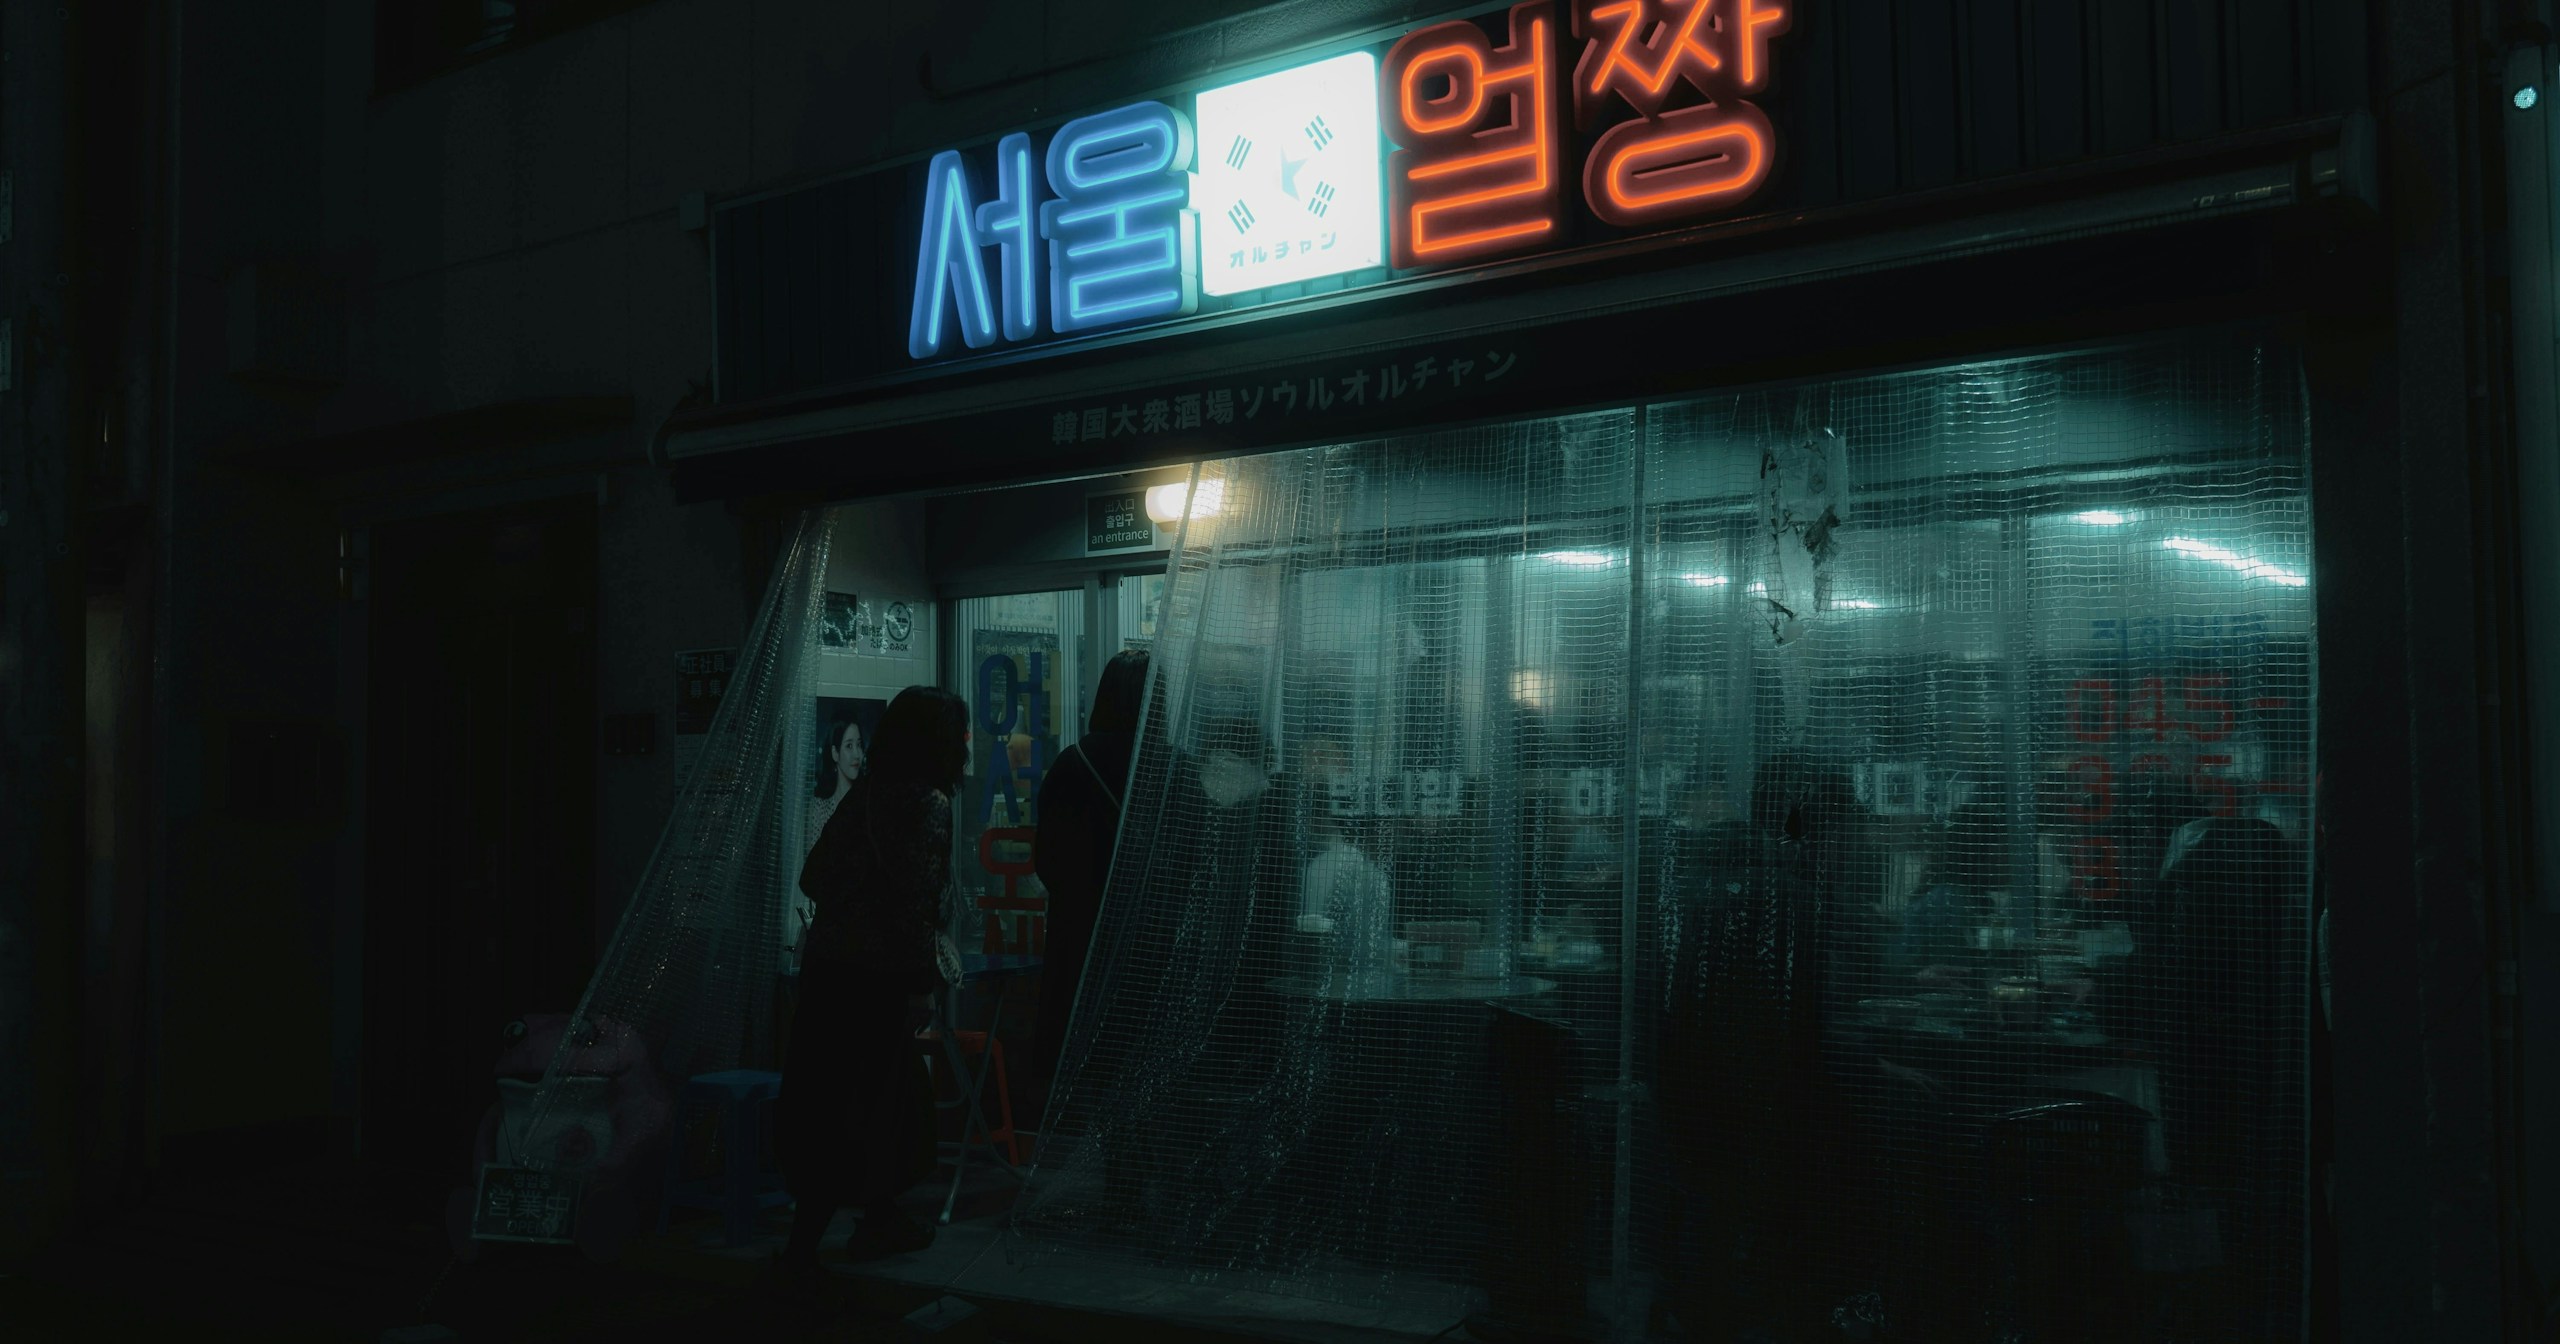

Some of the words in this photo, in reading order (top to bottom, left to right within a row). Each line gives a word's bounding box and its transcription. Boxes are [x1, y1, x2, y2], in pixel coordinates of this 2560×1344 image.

[908, 100, 1194, 360] 서울
[1382, 0, 1792, 270] 얼짱
[1229, 231, 1337, 268] オルチャン
[1051, 349, 1518, 446] 韓国大衆酒場ソウルオルチャン
[1104, 498, 1135, 513] 出入口
[1105, 513, 1135, 529] 출입구
[1091, 534, 1104, 545] an
[1105, 529, 1149, 543] entrance
[512, 1173, 551, 1190] 영업중
[487, 1184, 571, 1218] 営業中
[506, 1219, 549, 1234] OPEN
